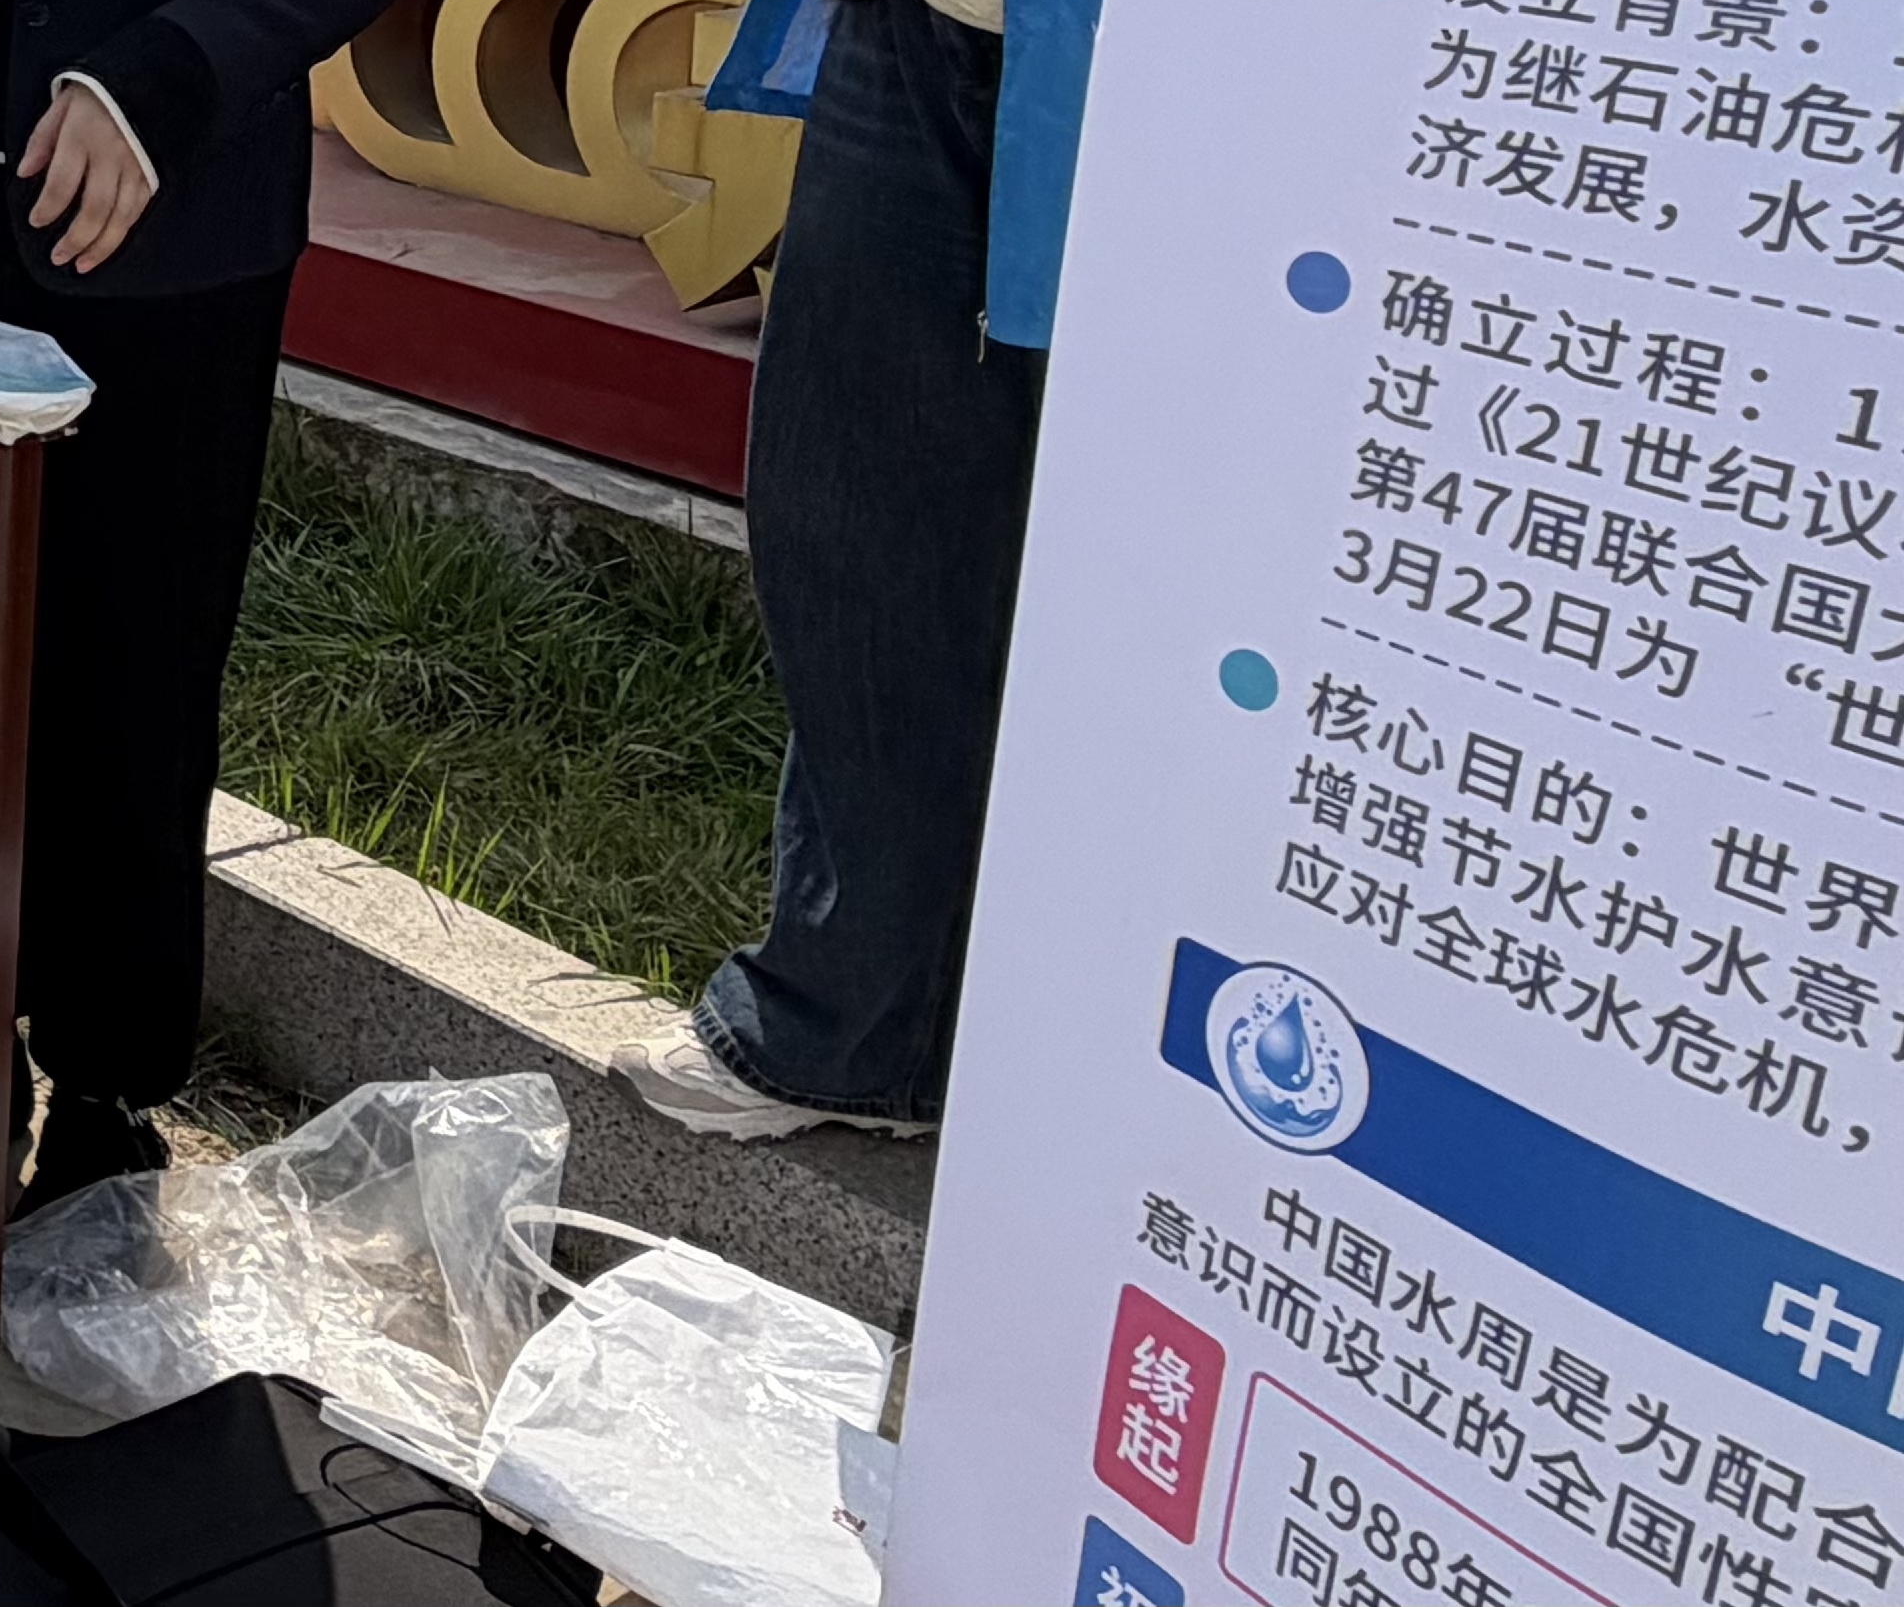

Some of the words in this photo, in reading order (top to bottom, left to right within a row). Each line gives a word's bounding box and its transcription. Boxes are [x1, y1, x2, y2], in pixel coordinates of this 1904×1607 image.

[1405, 113, 1904, 272] 济发展，水资
[1288, 754, 1904, 1063] 增强节水护水意
[1305, 672, 1900, 951] 核心目的：世界
[1275, 840, 1872, 1154] 应对全球水危机，
[1115, 1333, 1190, 1497] 缘起
[1135, 1191, 1862, 1607] 意识而设立的全国性
[1263, 1187, 1904, 1589] 中国水周是为配合
[1762, 1280, 1904, 1421] 中
[1288, 1450, 1513, 1607] 1988年
